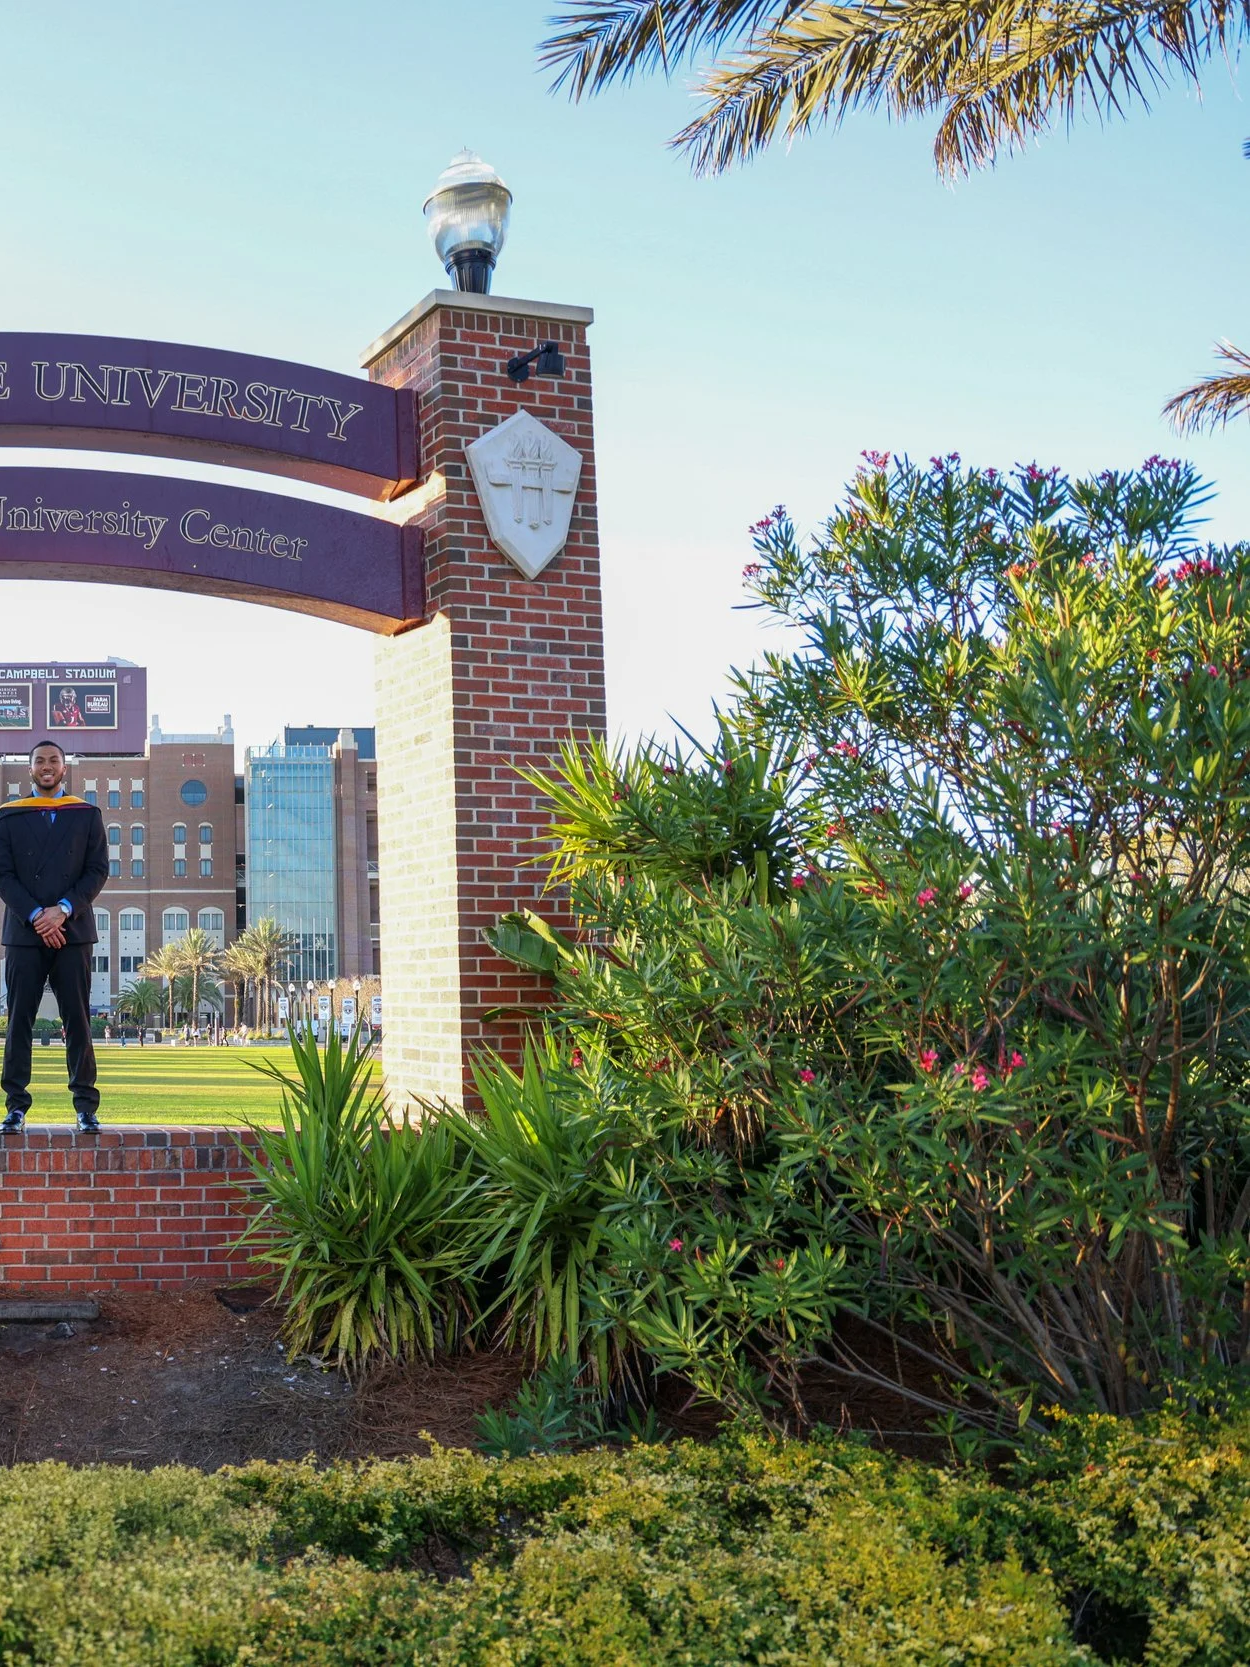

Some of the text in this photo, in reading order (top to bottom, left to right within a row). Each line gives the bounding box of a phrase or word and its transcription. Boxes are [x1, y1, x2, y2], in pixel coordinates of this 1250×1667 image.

[31, 361, 363, 441] UNIVERSITY
[179, 508, 308, 562] Center
[65, 668, 116, 679] STADIUM
